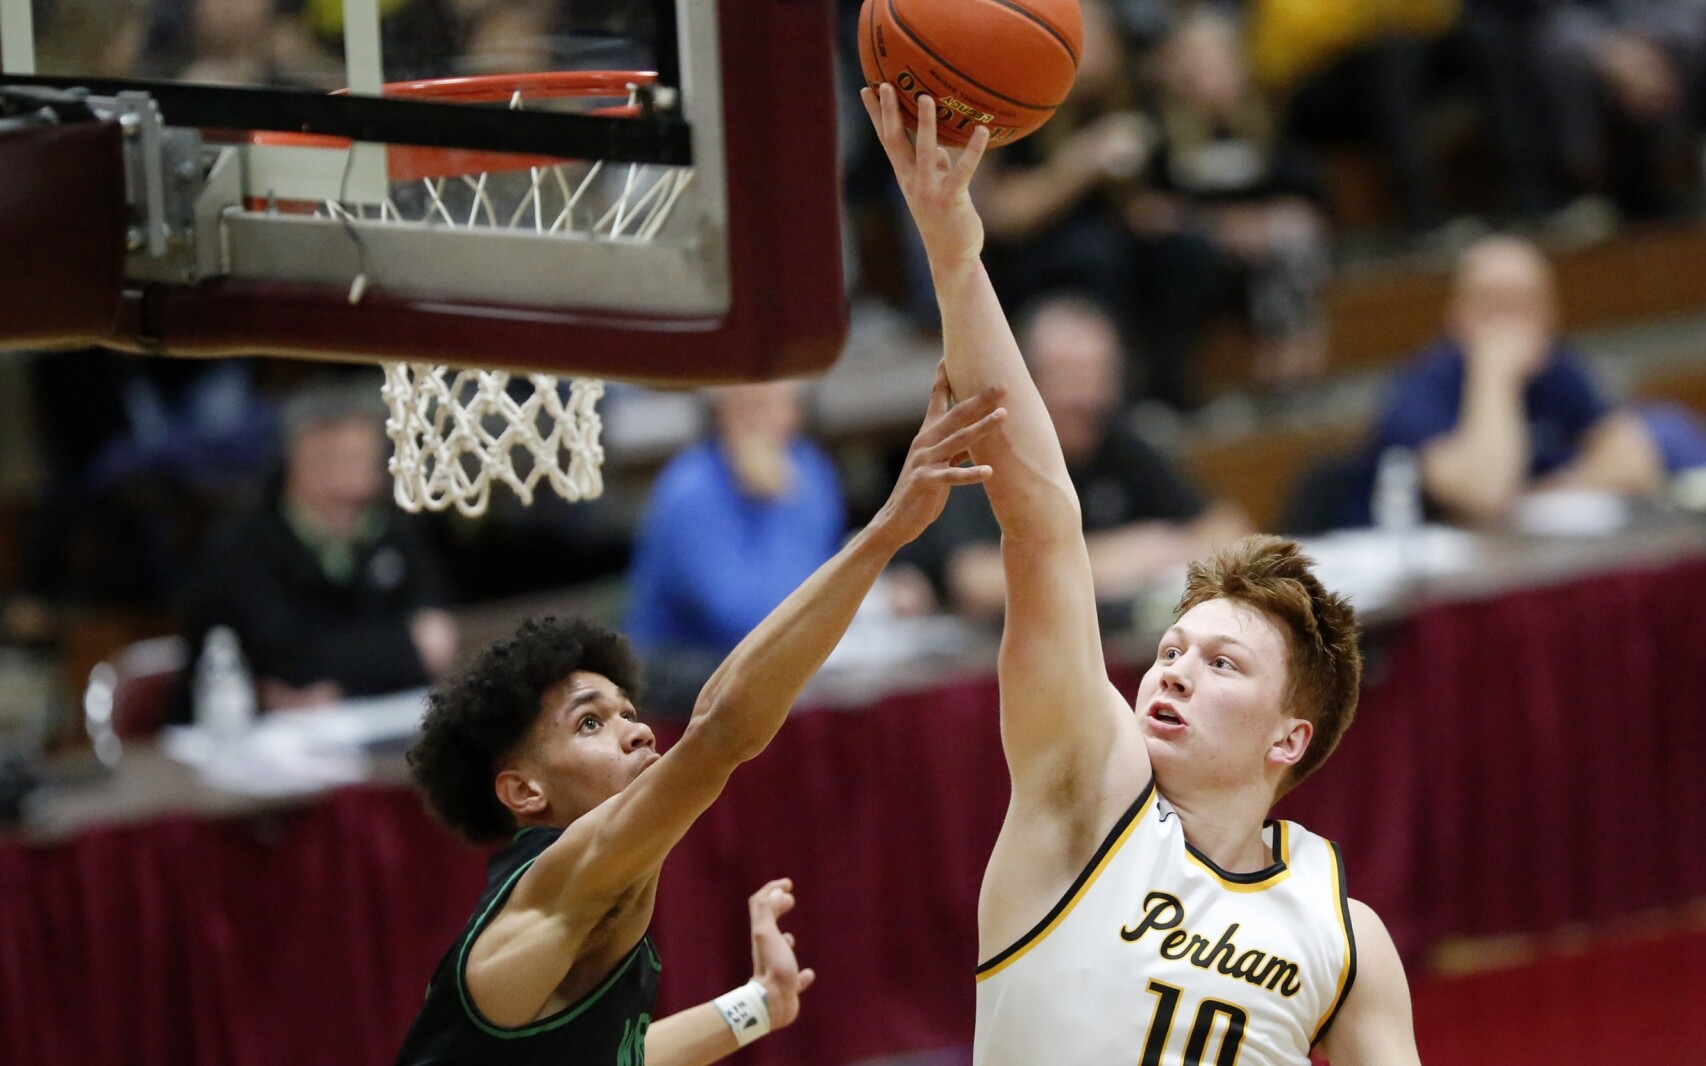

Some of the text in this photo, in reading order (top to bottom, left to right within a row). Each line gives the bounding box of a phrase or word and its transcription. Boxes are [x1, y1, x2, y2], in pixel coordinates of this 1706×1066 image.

[940, 95, 995, 123] LEGACY
[1119, 890, 1302, 999] Perham
[1138, 977, 1250, 1066] 10
